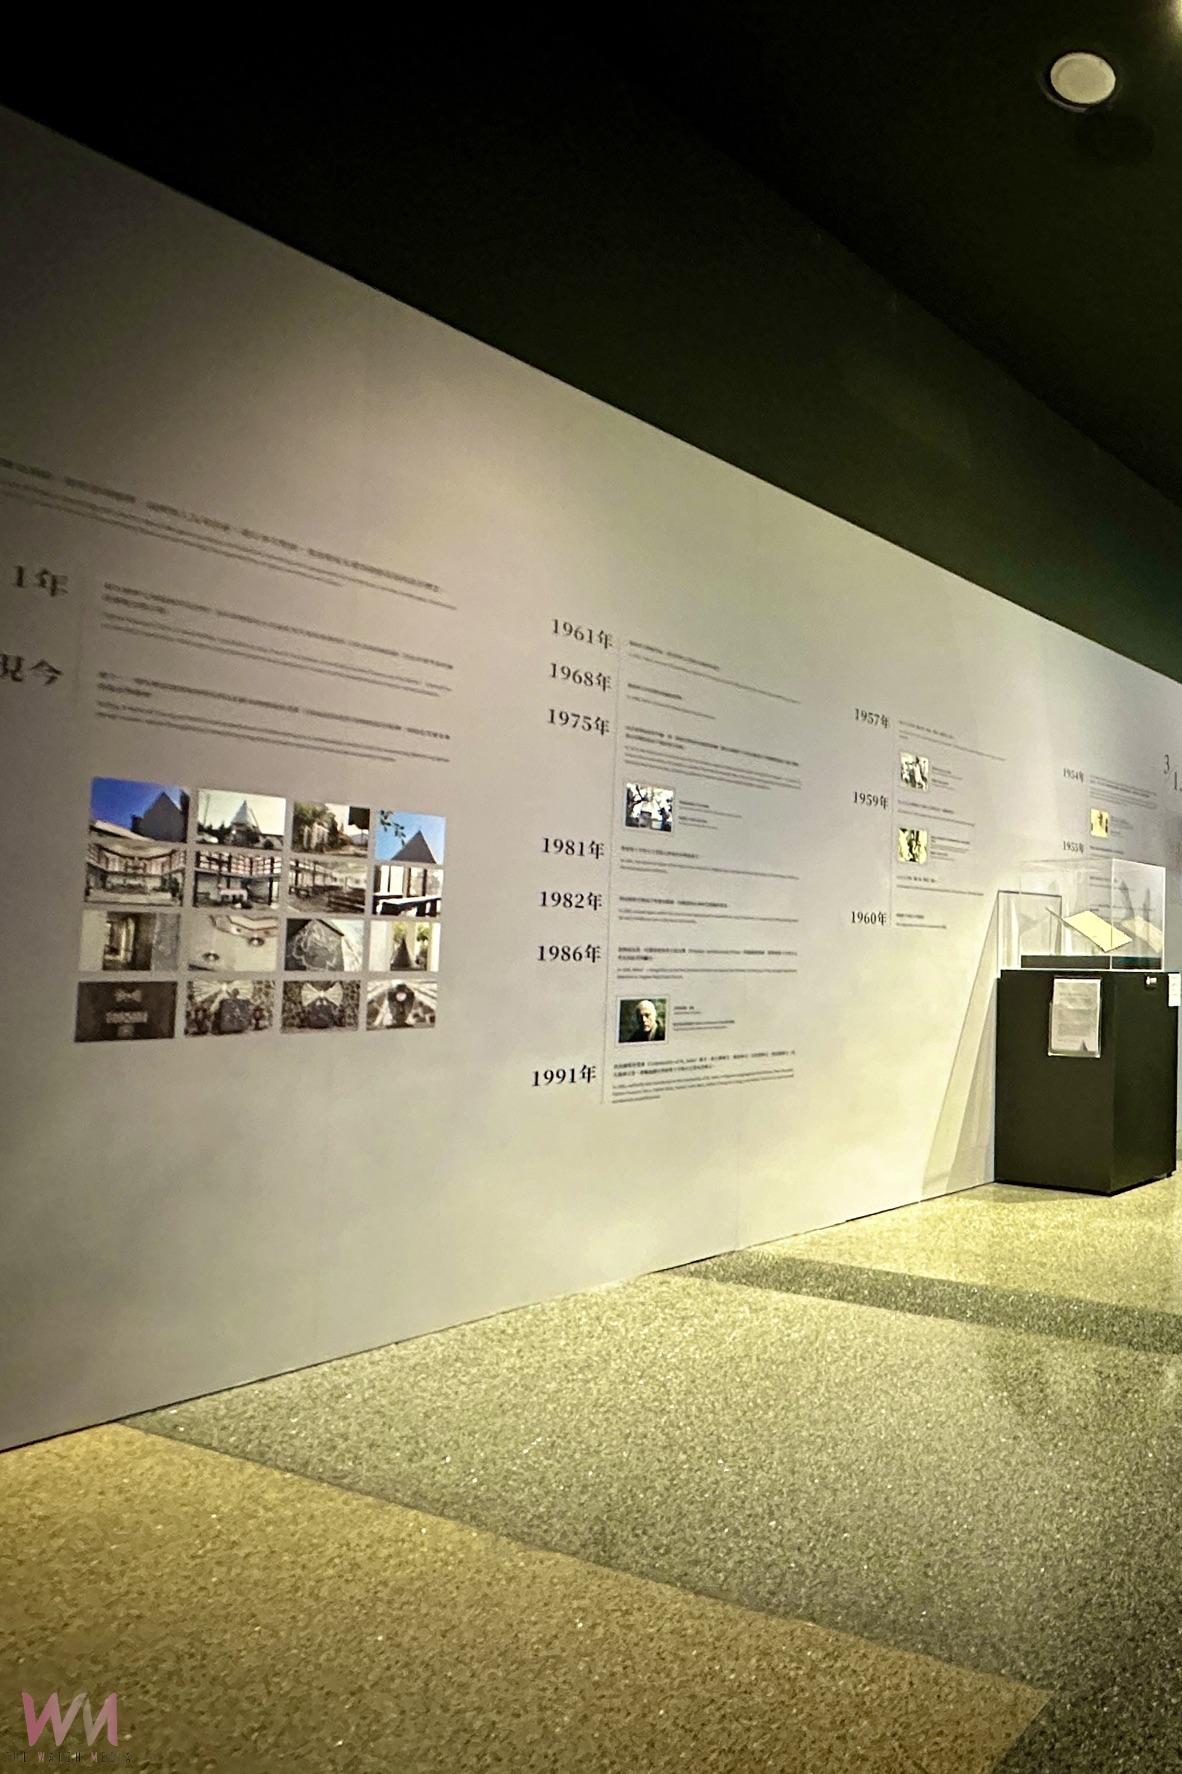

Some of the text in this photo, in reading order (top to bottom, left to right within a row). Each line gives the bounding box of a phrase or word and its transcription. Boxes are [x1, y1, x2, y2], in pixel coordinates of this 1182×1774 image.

[551, 618, 613, 650] 1961年
[550, 662, 611, 692] 1968年
[547, 708, 610, 736] 1975年
[854, 708, 890, 729] 1957年
[853, 791, 888, 810] 1959年
[542, 837, 605, 860] 1981年
[540, 891, 603, 911] 1982年
[851, 911, 887, 927] 1960年
[537, 944, 601, 963] 1986年
[532, 1064, 597, 1087] 1991年
